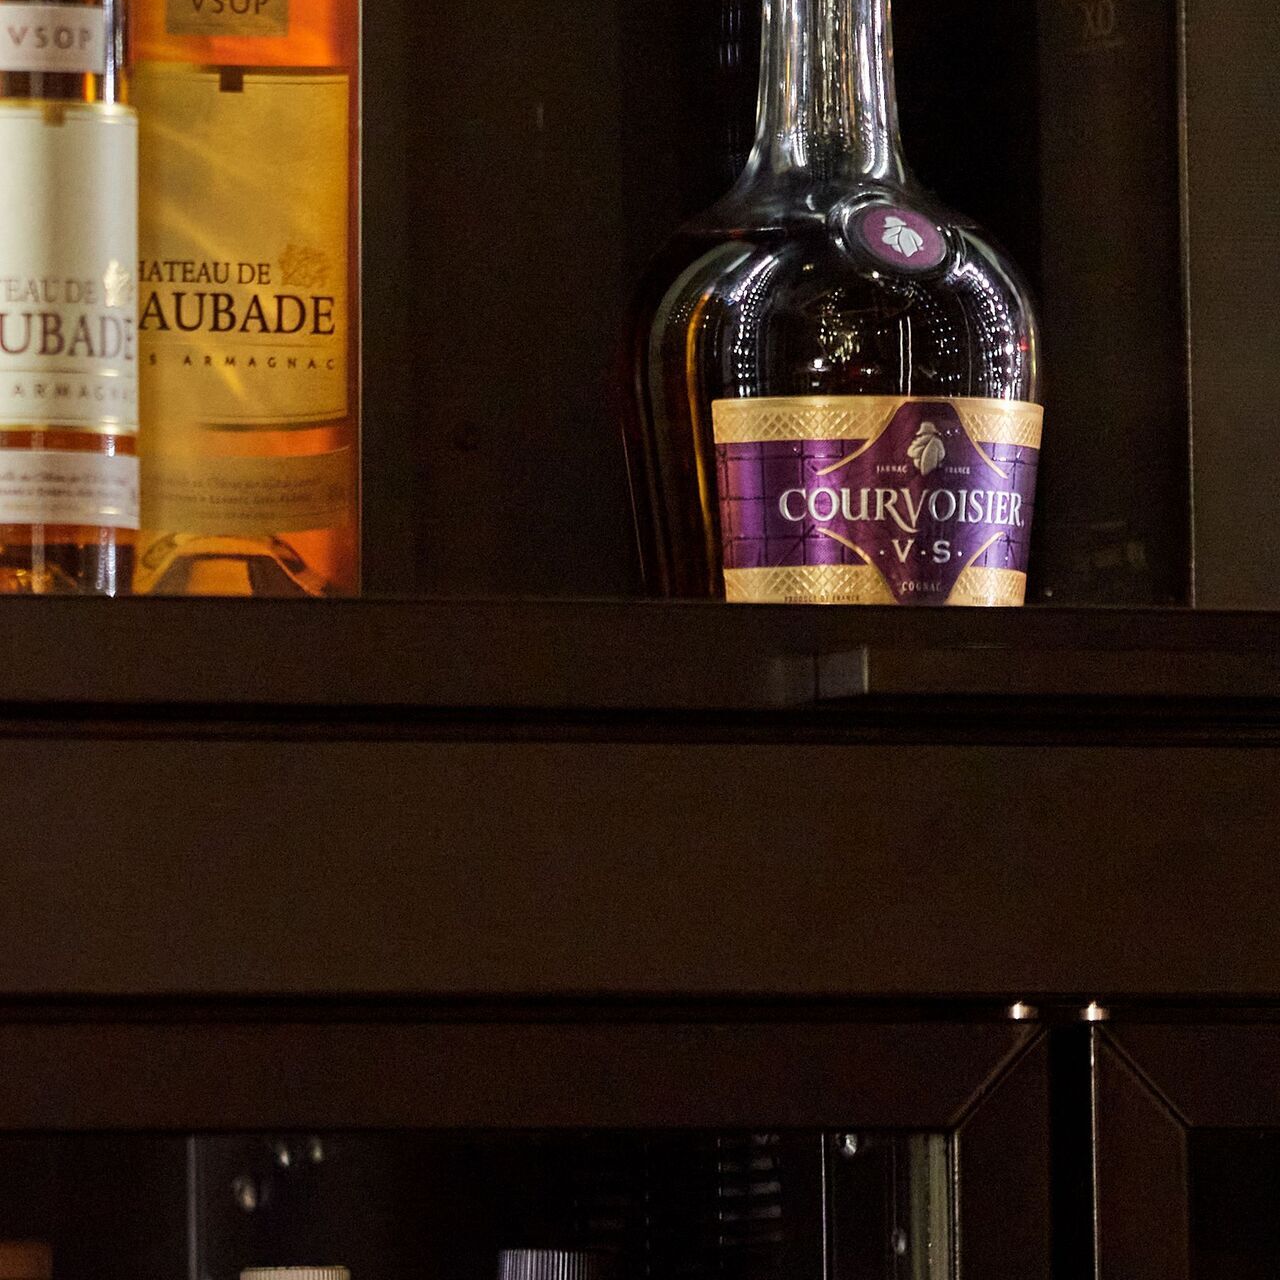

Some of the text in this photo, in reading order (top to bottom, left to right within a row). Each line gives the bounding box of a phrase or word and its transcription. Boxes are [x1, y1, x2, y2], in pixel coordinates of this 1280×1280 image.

[8, 25, 92, 50] VSOP
[236, 262, 272, 286] DE
[137, 291, 336, 336] AUBADE
[181, 352, 337, 370] ARMAGNAC
[778, 486, 1022, 534] COURVOISIER
